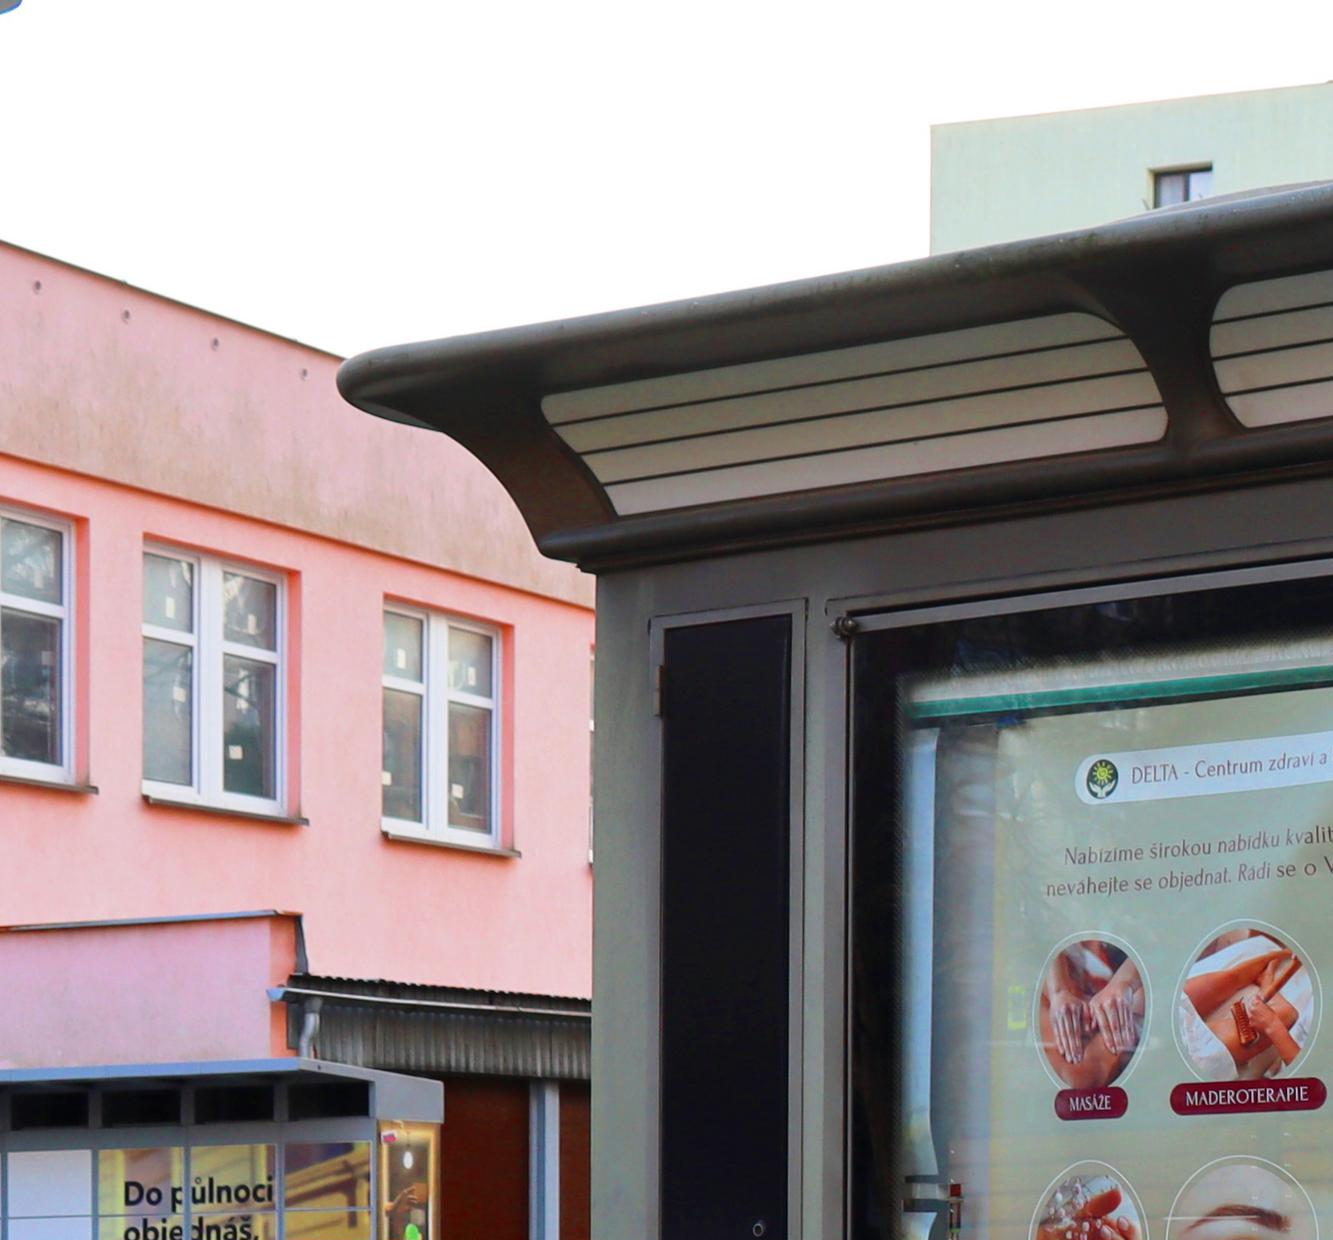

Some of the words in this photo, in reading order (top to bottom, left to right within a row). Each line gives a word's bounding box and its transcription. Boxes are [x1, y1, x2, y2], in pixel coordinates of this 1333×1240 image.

[1131, 763, 1178, 785] DELTA
[1195, 759, 1263, 779] Centrum
[1268, 750, 1315, 771] zdraví
[1319, 753, 1328, 766] a
[1063, 847, 1145, 866] Nabízíme
[1149, 839, 1212, 860] širokou
[1217, 831, 1280, 854] nabídku
[1046, 875, 1129, 897] neváhejte
[1134, 878, 1153, 891] se
[1158, 867, 1232, 893] objednat.
[1237, 861, 1271, 882] Rádi
[1276, 864, 1297, 879] se
[1303, 862, 1317, 877] o
[1069, 1092, 1112, 1113] MASÁŽE
[1185, 1086, 1309, 1107] MADEROTERAPIE
[124, 1180, 163, 1207] Do
[171, 1175, 273, 1213] půlnoci
